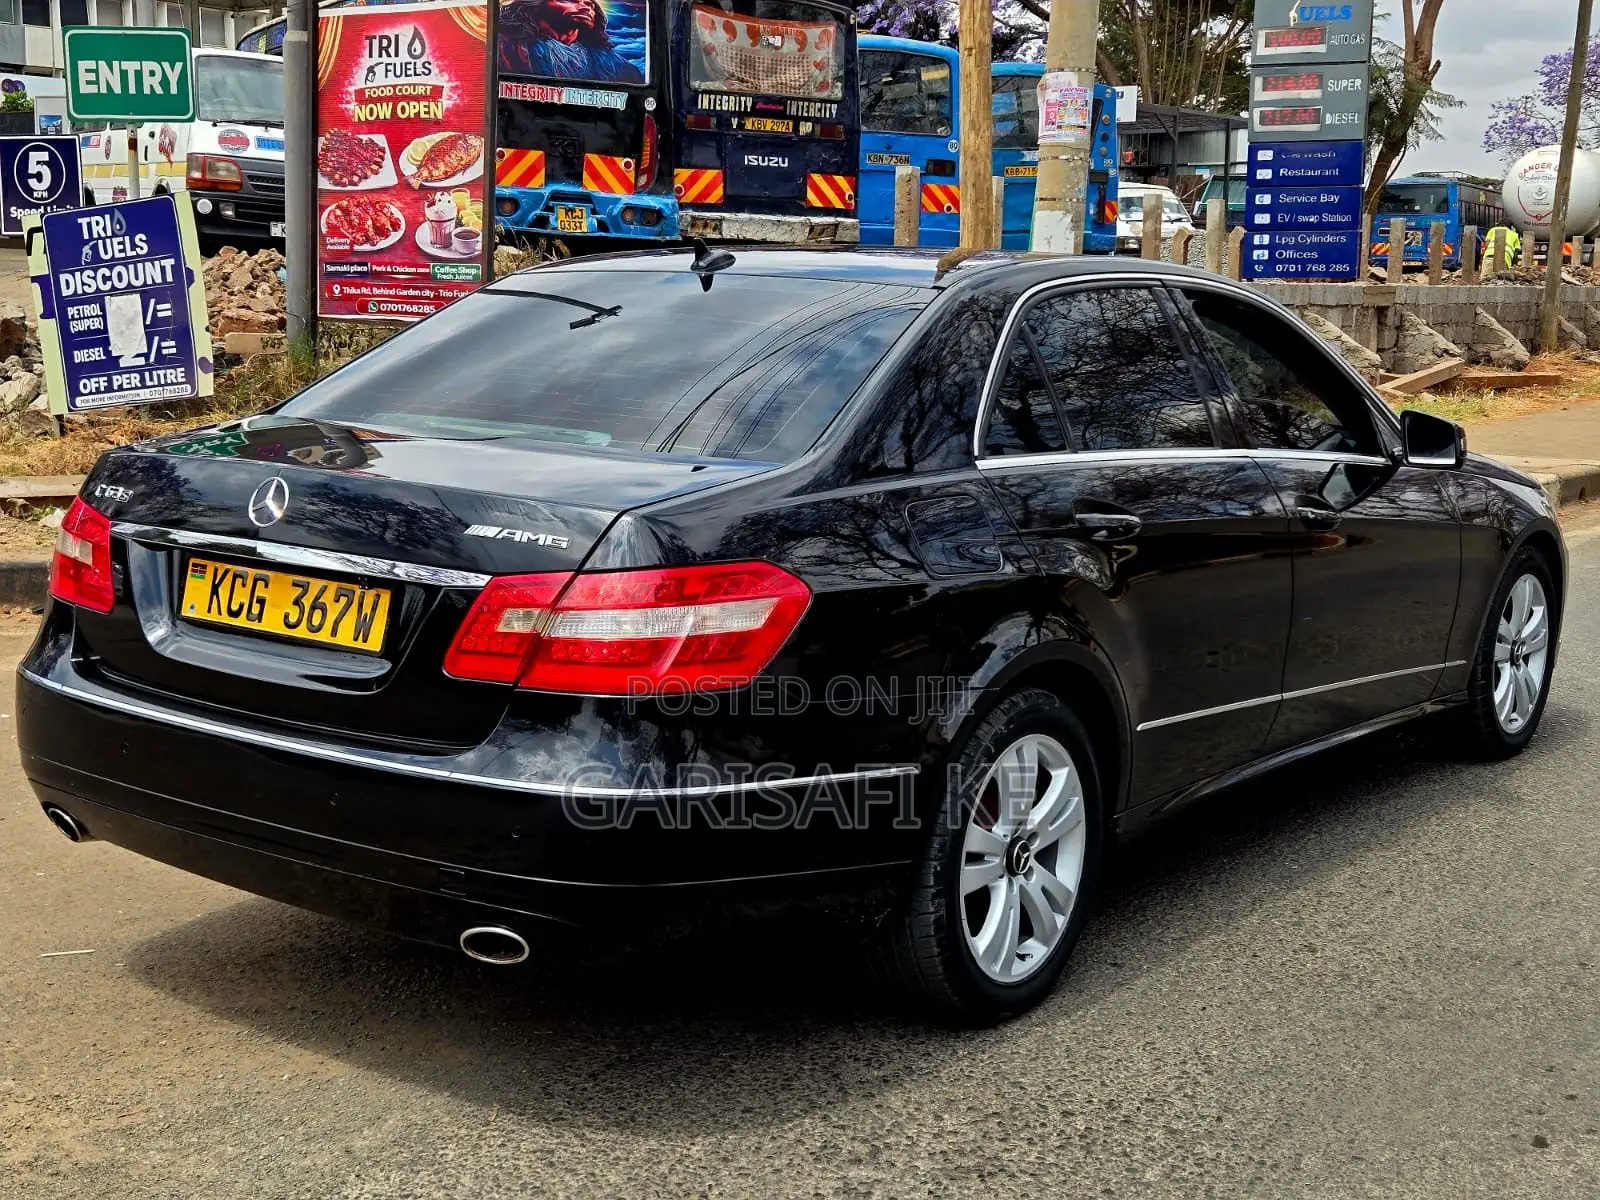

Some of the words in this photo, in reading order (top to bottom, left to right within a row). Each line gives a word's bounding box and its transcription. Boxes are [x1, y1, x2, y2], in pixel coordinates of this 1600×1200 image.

[1330, 34, 1349, 45] AUTO
[1350, 33, 1365, 44] GAS
[384, 61, 432, 79] FUELS
[77, 60, 184, 94] ENTRY
[1327, 78, 1362, 91] SUPER
[365, 86, 393, 98] FOOD
[395, 85, 432, 96] COURT
[499, 81, 564, 104] INTEGRITY
[564, 87, 629, 111] INTERCITY
[698, 93, 753, 112] INTEGRITY
[354, 102, 393, 122] NOW
[396, 101, 443, 120] OPEN
[786, 100, 838, 118] INTERCITY
[751, 119, 768, 130] KBV
[1325, 112, 1360, 125] DIESEL
[744, 154, 789, 167] ISUZU
[867, 154, 884, 164] KBN
[27, 151, 52, 191] 5
[1022, 167, 1039, 176] 715
[1279, 168, 1339, 177] Restaurant
[33, 190, 48, 198] KPH
[1279, 193, 1317, 203] Service
[1320, 193, 1340, 204] Bay
[564, 209, 584, 220] KCJ
[1277, 213, 1291, 223] EV
[1297, 215, 1320, 224] swap
[1322, 213, 1352, 222] Station
[326, 237, 351, 245] Delivery
[1275, 235, 1295, 245] Lpg
[1298, 234, 1347, 244] Cylinders
[1275, 249, 1319, 259] Offices
[326, 264, 350, 272] Samaki
[350, 264, 368, 273] place
[435, 266, 457, 274] Coffee
[458, 266, 477, 275] Shop
[1275, 264, 1301, 272] 0701
[1306, 264, 1326, 272] 768
[1329, 263, 1350, 272] 285
[59, 258, 175, 297] DISCOUNT
[342, 286, 361, 294] Thika
[373, 287, 396, 295] Behind
[396, 288, 421, 296] Garden
[422, 289, 434, 298] city
[440, 289, 452, 297] Trio
[67, 303, 103, 319] PETROL
[380, 303, 436, 313] 0701768285
[70, 317, 104, 334] (SUPER)
[73, 347, 107, 363] DIESEL
[79, 376, 108, 394] OFF
[112, 373, 142, 390] PER
[144, 368, 187, 386] LITRE
[207, 566, 270, 623] KCG
[283, 580, 381, 643] 367W
